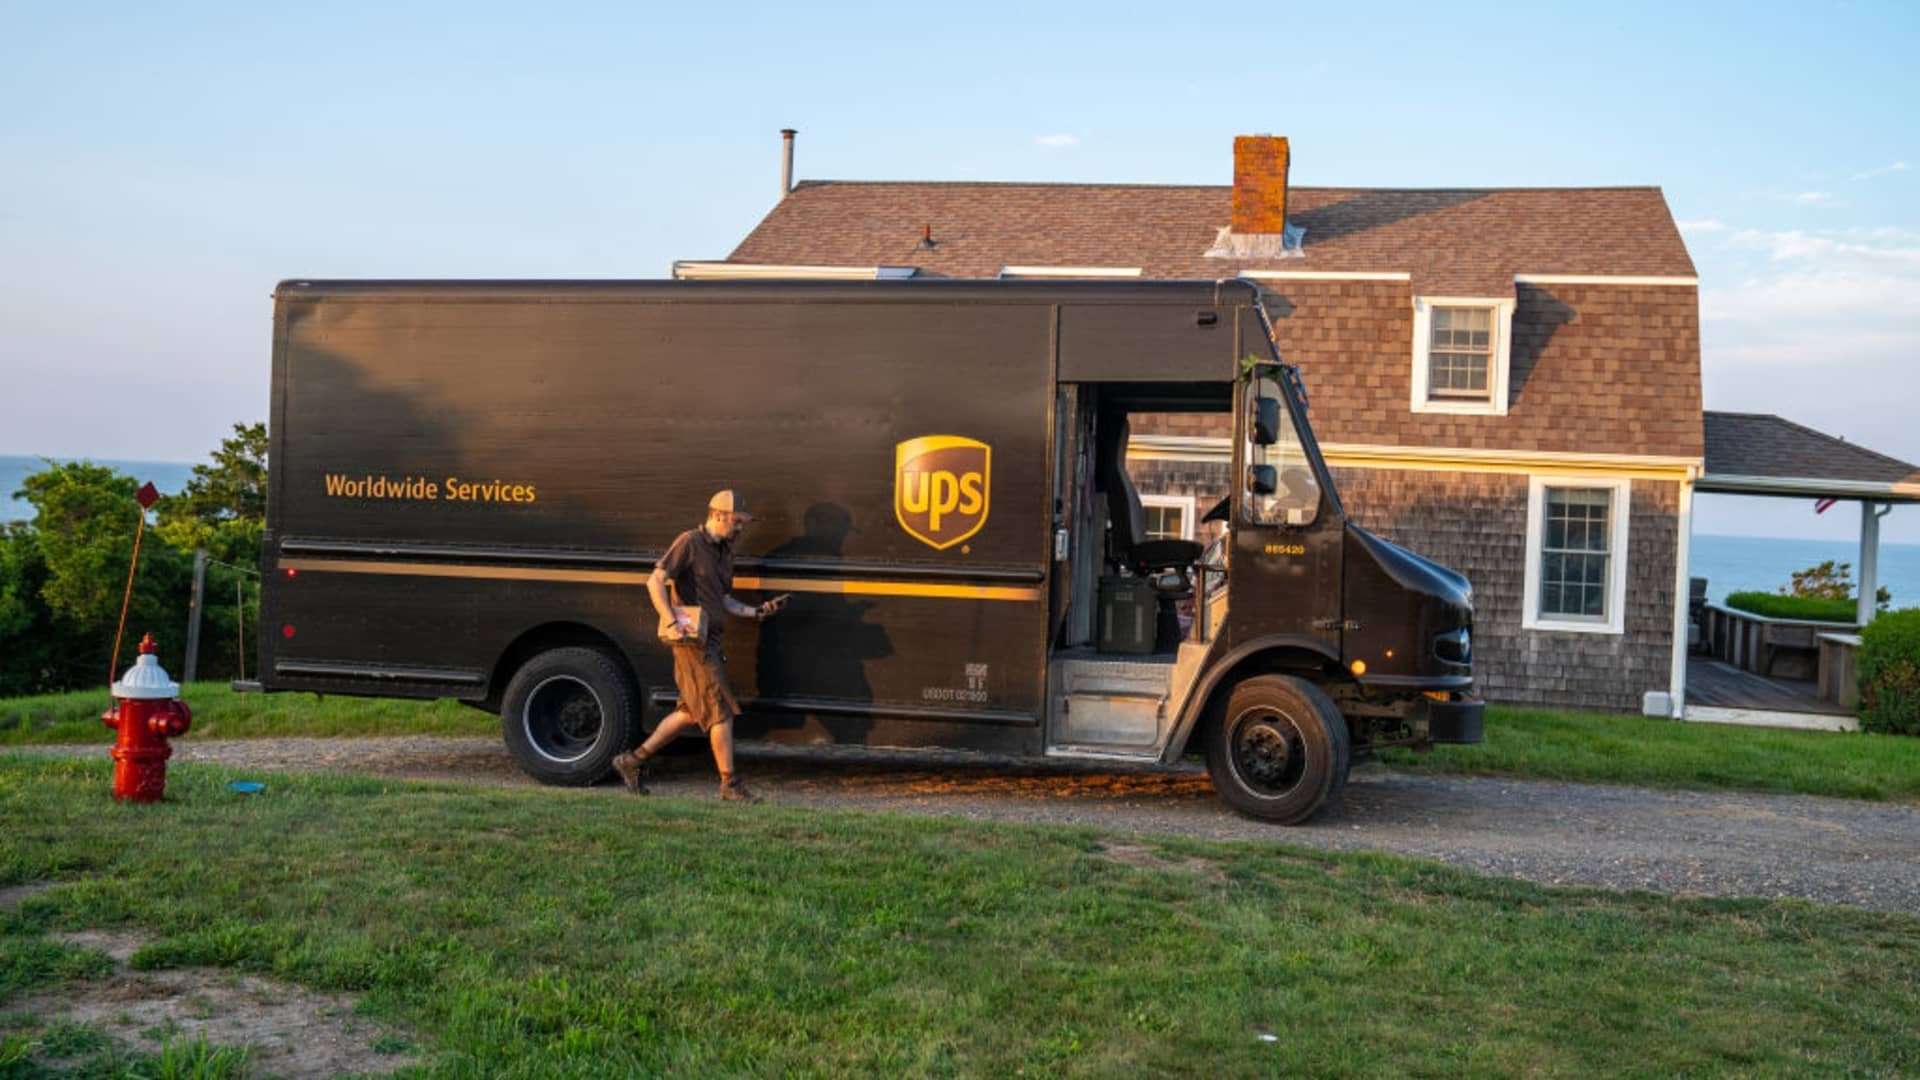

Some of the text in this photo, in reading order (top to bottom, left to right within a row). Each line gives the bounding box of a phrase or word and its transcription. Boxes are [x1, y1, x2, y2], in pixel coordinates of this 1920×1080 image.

[325, 474, 536, 503] Worldwide Services
[903, 470, 983, 532] ups
